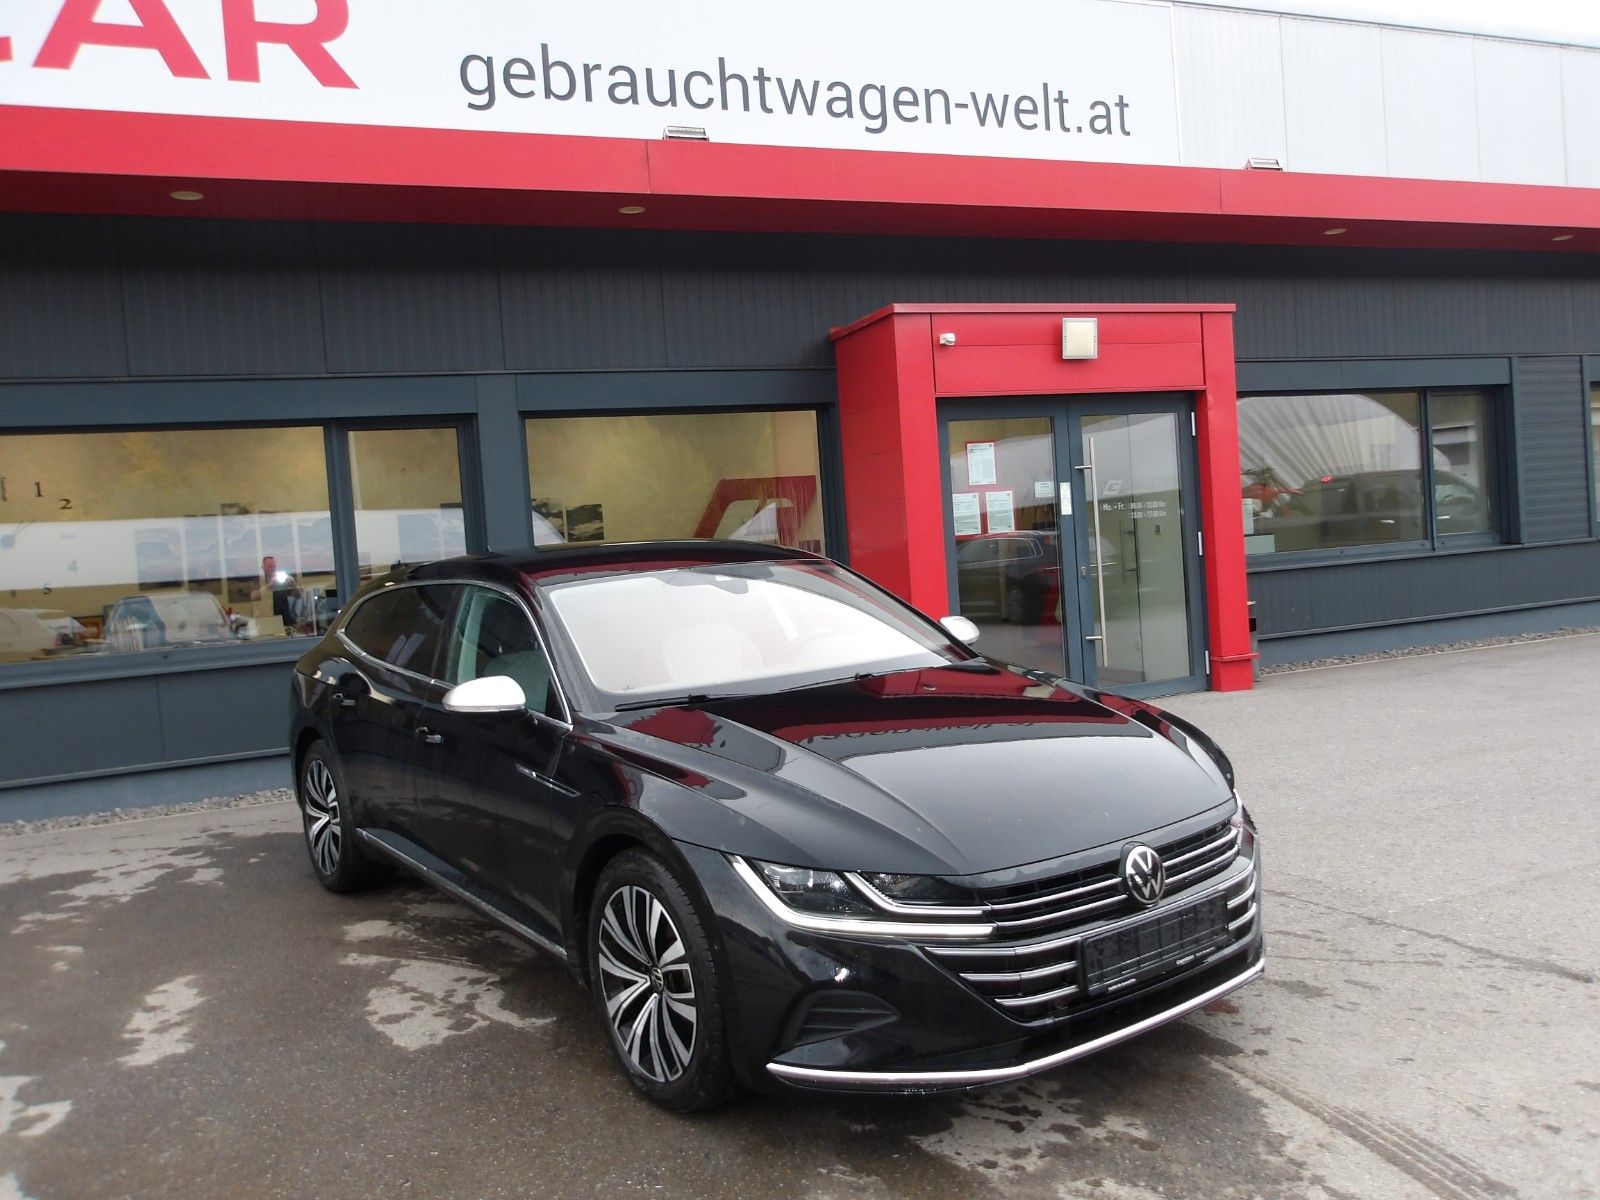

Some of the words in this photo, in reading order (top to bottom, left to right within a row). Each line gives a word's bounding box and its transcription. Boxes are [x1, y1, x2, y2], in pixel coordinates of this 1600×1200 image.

[459, 43, 1131, 136] gebrauchtwagen-welt.at
[59, 498, 73, 510] 2
[67, 560, 78, 573] 4
